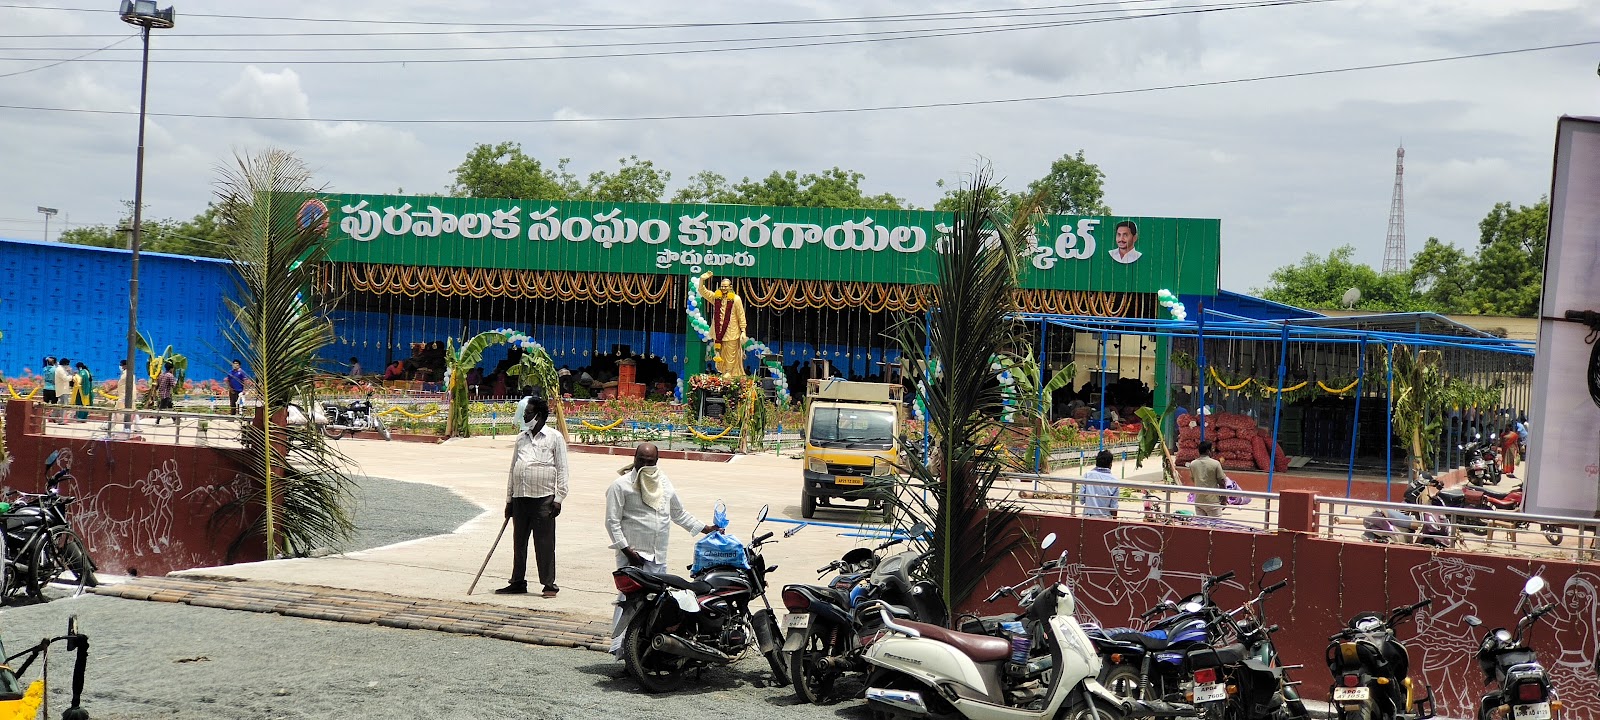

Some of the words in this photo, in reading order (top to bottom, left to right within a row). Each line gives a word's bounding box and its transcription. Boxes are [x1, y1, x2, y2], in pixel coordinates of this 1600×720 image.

[340, 200, 521, 242] పురపాలక
[528, 206, 670, 249] సంఘం
[678, 211, 927, 253] కూరగాయల
